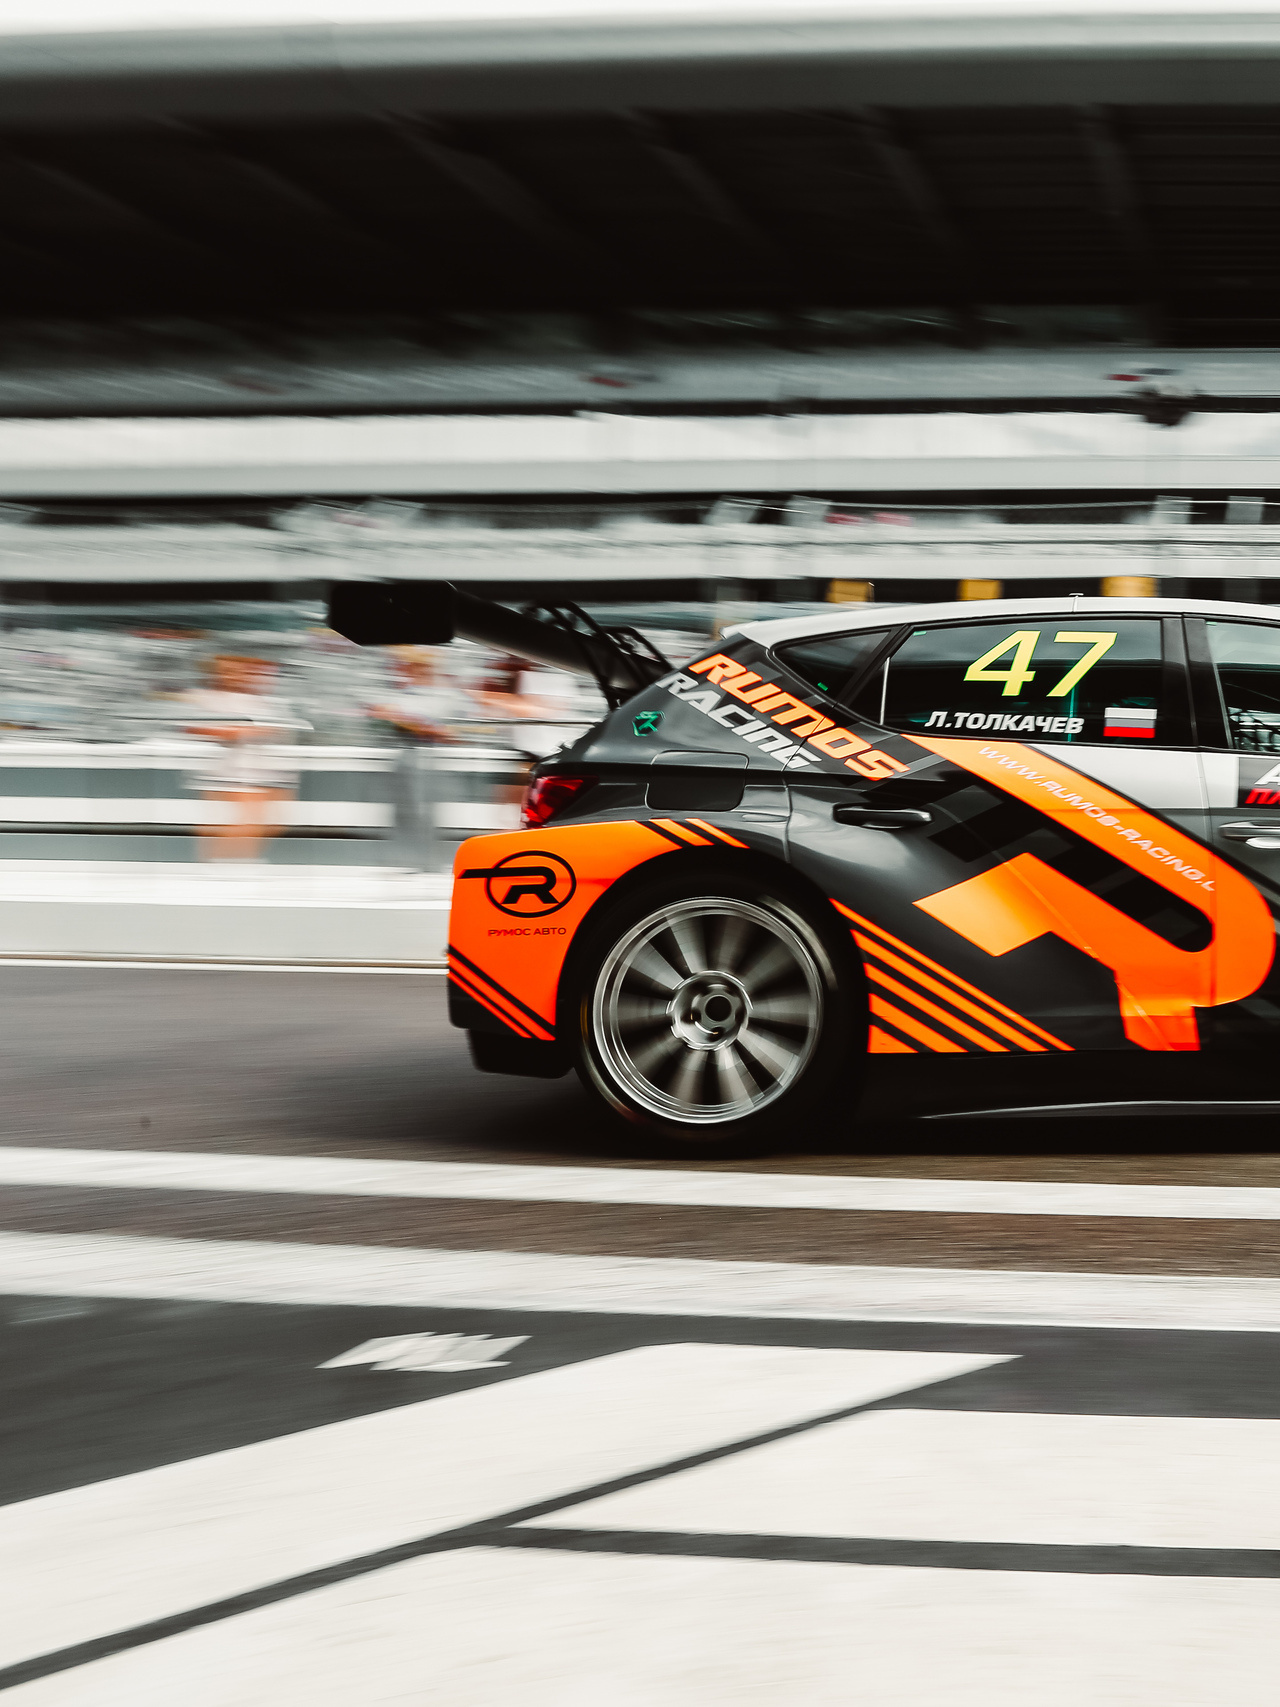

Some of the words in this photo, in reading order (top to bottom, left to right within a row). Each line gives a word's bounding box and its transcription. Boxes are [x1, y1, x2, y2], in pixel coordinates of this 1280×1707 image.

[963, 629, 1118, 698] 47
[655, 671, 823, 770] RACING
[688, 652, 911, 782] RUMOS
[924, 709, 1085, 735] Л.ТОЛКАЧЕВ
[533, 927, 567, 936] АВТО
